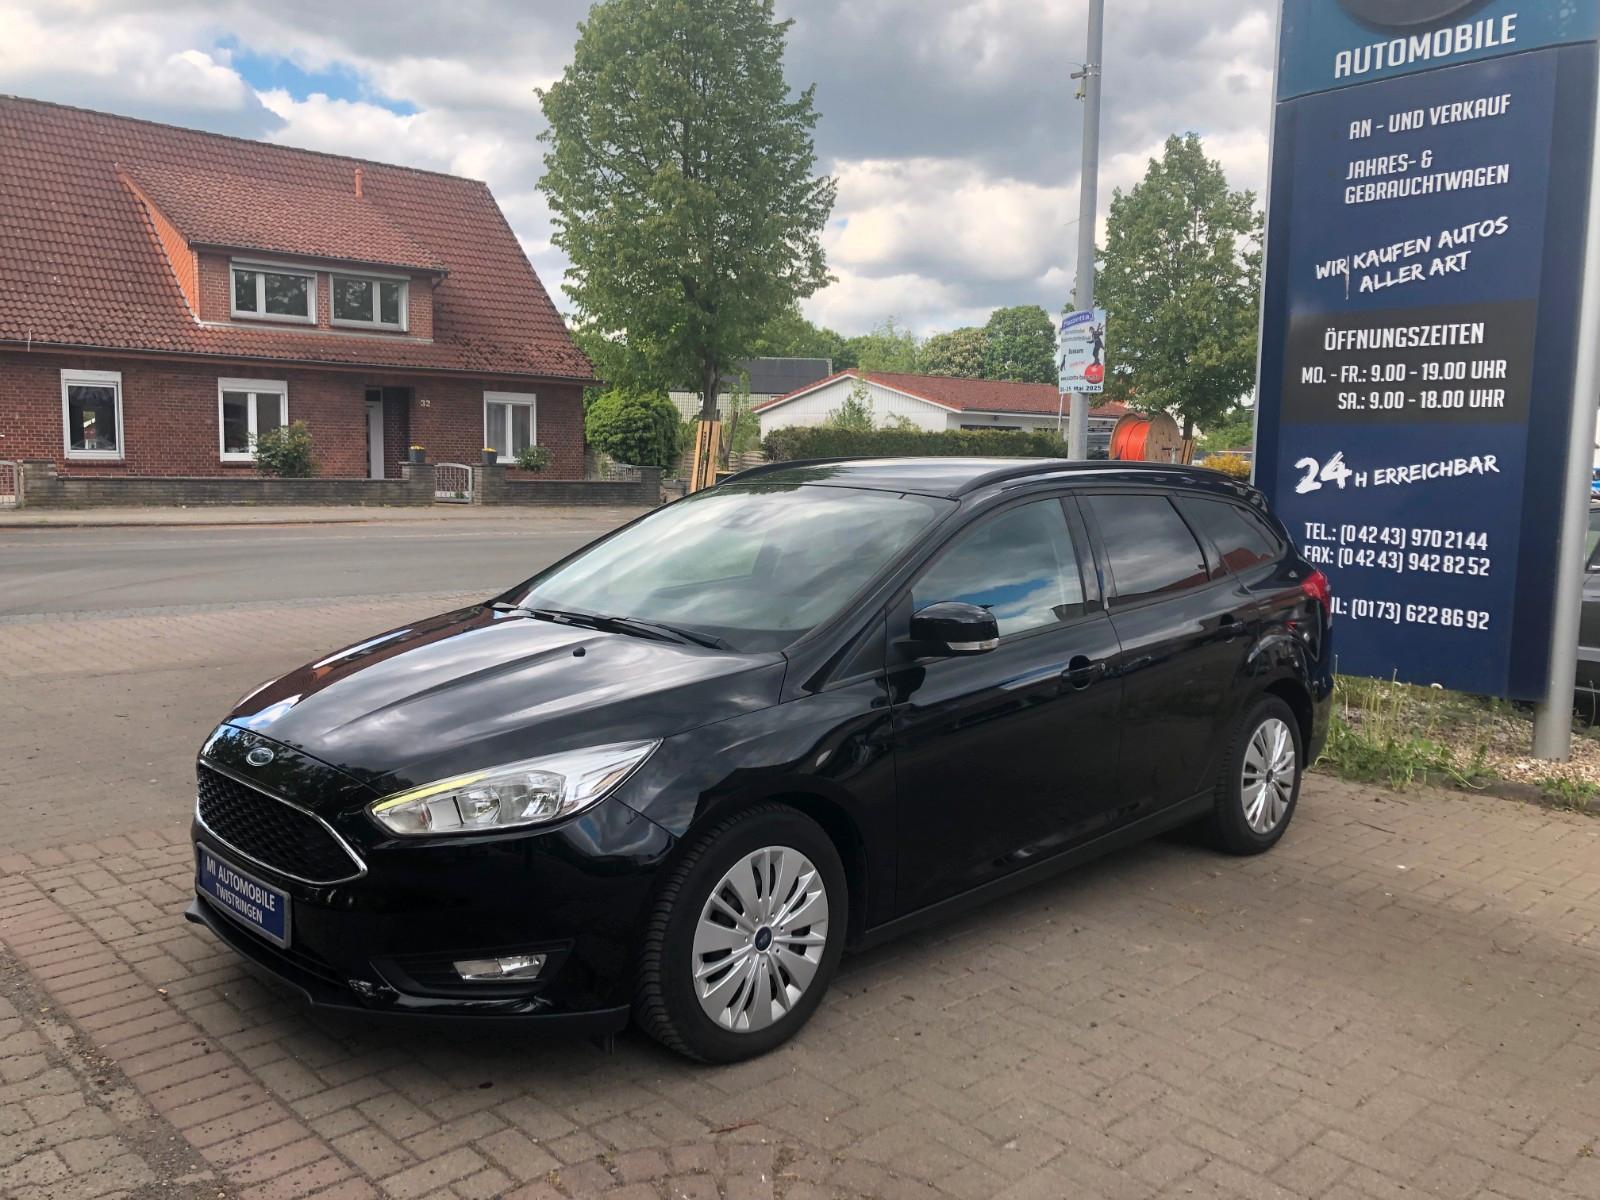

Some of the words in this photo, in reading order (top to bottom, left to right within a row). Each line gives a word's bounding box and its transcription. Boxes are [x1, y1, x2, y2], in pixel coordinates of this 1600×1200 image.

[1334, 13, 1517, 79] AUTOMOBILE
[1349, 119, 1371, 139] AN
[1389, 109, 1424, 133] UND
[1430, 94, 1511, 126] VERKAUF
[1345, 164, 1510, 204] GEBRAUCHTWAGEN
[1346, 154, 1416, 180] JAHRES-
[1421, 150, 1433, 168] &
[1316, 258, 1349, 288] WIR
[1353, 237, 1431, 269] KAUFEN
[1438, 216, 1509, 248] AUTOS
[1359, 265, 1425, 293] ALLER
[1429, 251, 1471, 276] ART
[1324, 322, 1485, 351] ÖFFNUNGSZEITEN
[1301, 367, 1326, 384] MO.
[1341, 365, 1367, 383] FR.:
[1371, 364, 1406, 382] 9.00
[1422, 362, 1466, 380] 19.00
[1471, 361, 1507, 379] UHR
[1338, 392, 1365, 409] SA.:
[1369, 392, 1404, 409] 9.00
[1420, 390, 1464, 408] 18.00
[1469, 389, 1505, 407] UHR
[1294, 451, 1352, 494] 24
[1355, 472, 1367, 487] H
[1374, 454, 1500, 486] ERREICHBAR
[1305, 522, 1336, 541] TEL.:
[1305, 545, 1334, 563] FAX:
[1330, 597, 1348, 615] IL:
[1352, 599, 1400, 624] (0173)
[206, 855, 216, 876] MI
[218, 867, 275, 912] AUTOMOBILE
[216, 883, 263, 924] TWISTRINGEN
